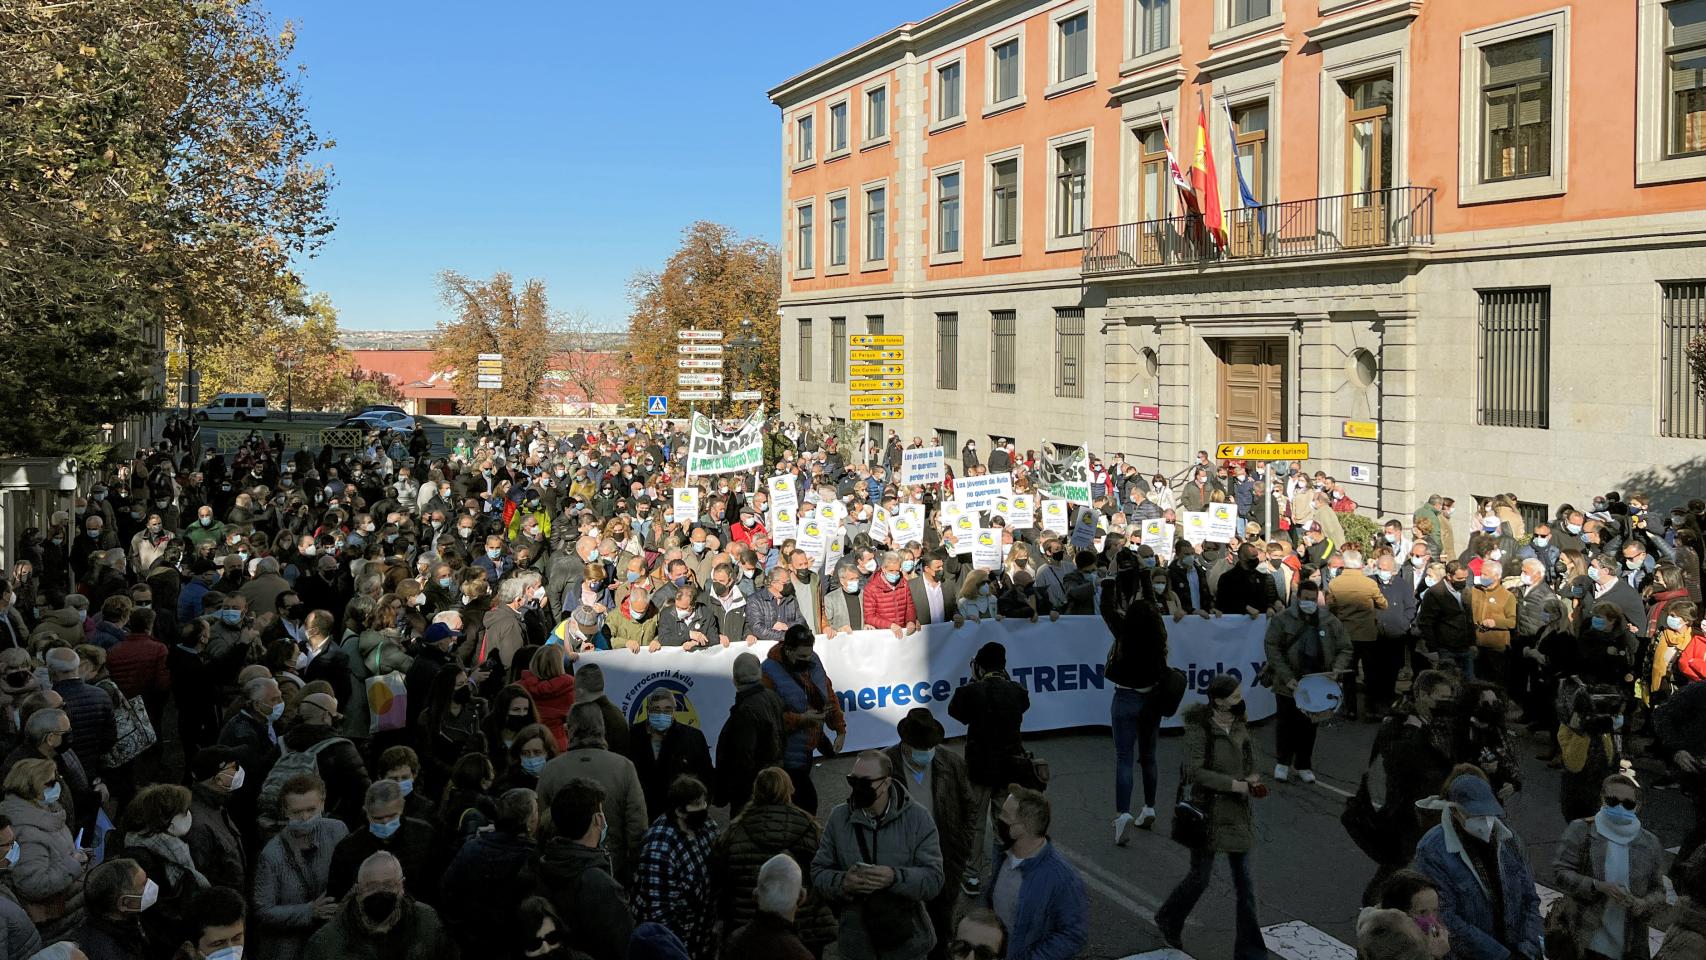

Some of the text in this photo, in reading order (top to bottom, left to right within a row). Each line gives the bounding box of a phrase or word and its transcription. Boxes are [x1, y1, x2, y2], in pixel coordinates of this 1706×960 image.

[1246, 447, 1270, 455] oficina
[1272, 447, 1281, 455] de
[1282, 447, 1306, 455] turismo
[918, 462, 937, 470] queremos
[909, 474, 924, 482] perder
[989, 477, 996, 485] de
[975, 488, 1000, 497] queremos
[965, 498, 992, 509] perder el
[1013, 663, 1105, 693] TREN
[625, 669, 671, 701] Ferrocarril
[672, 669, 694, 688] Ávila
